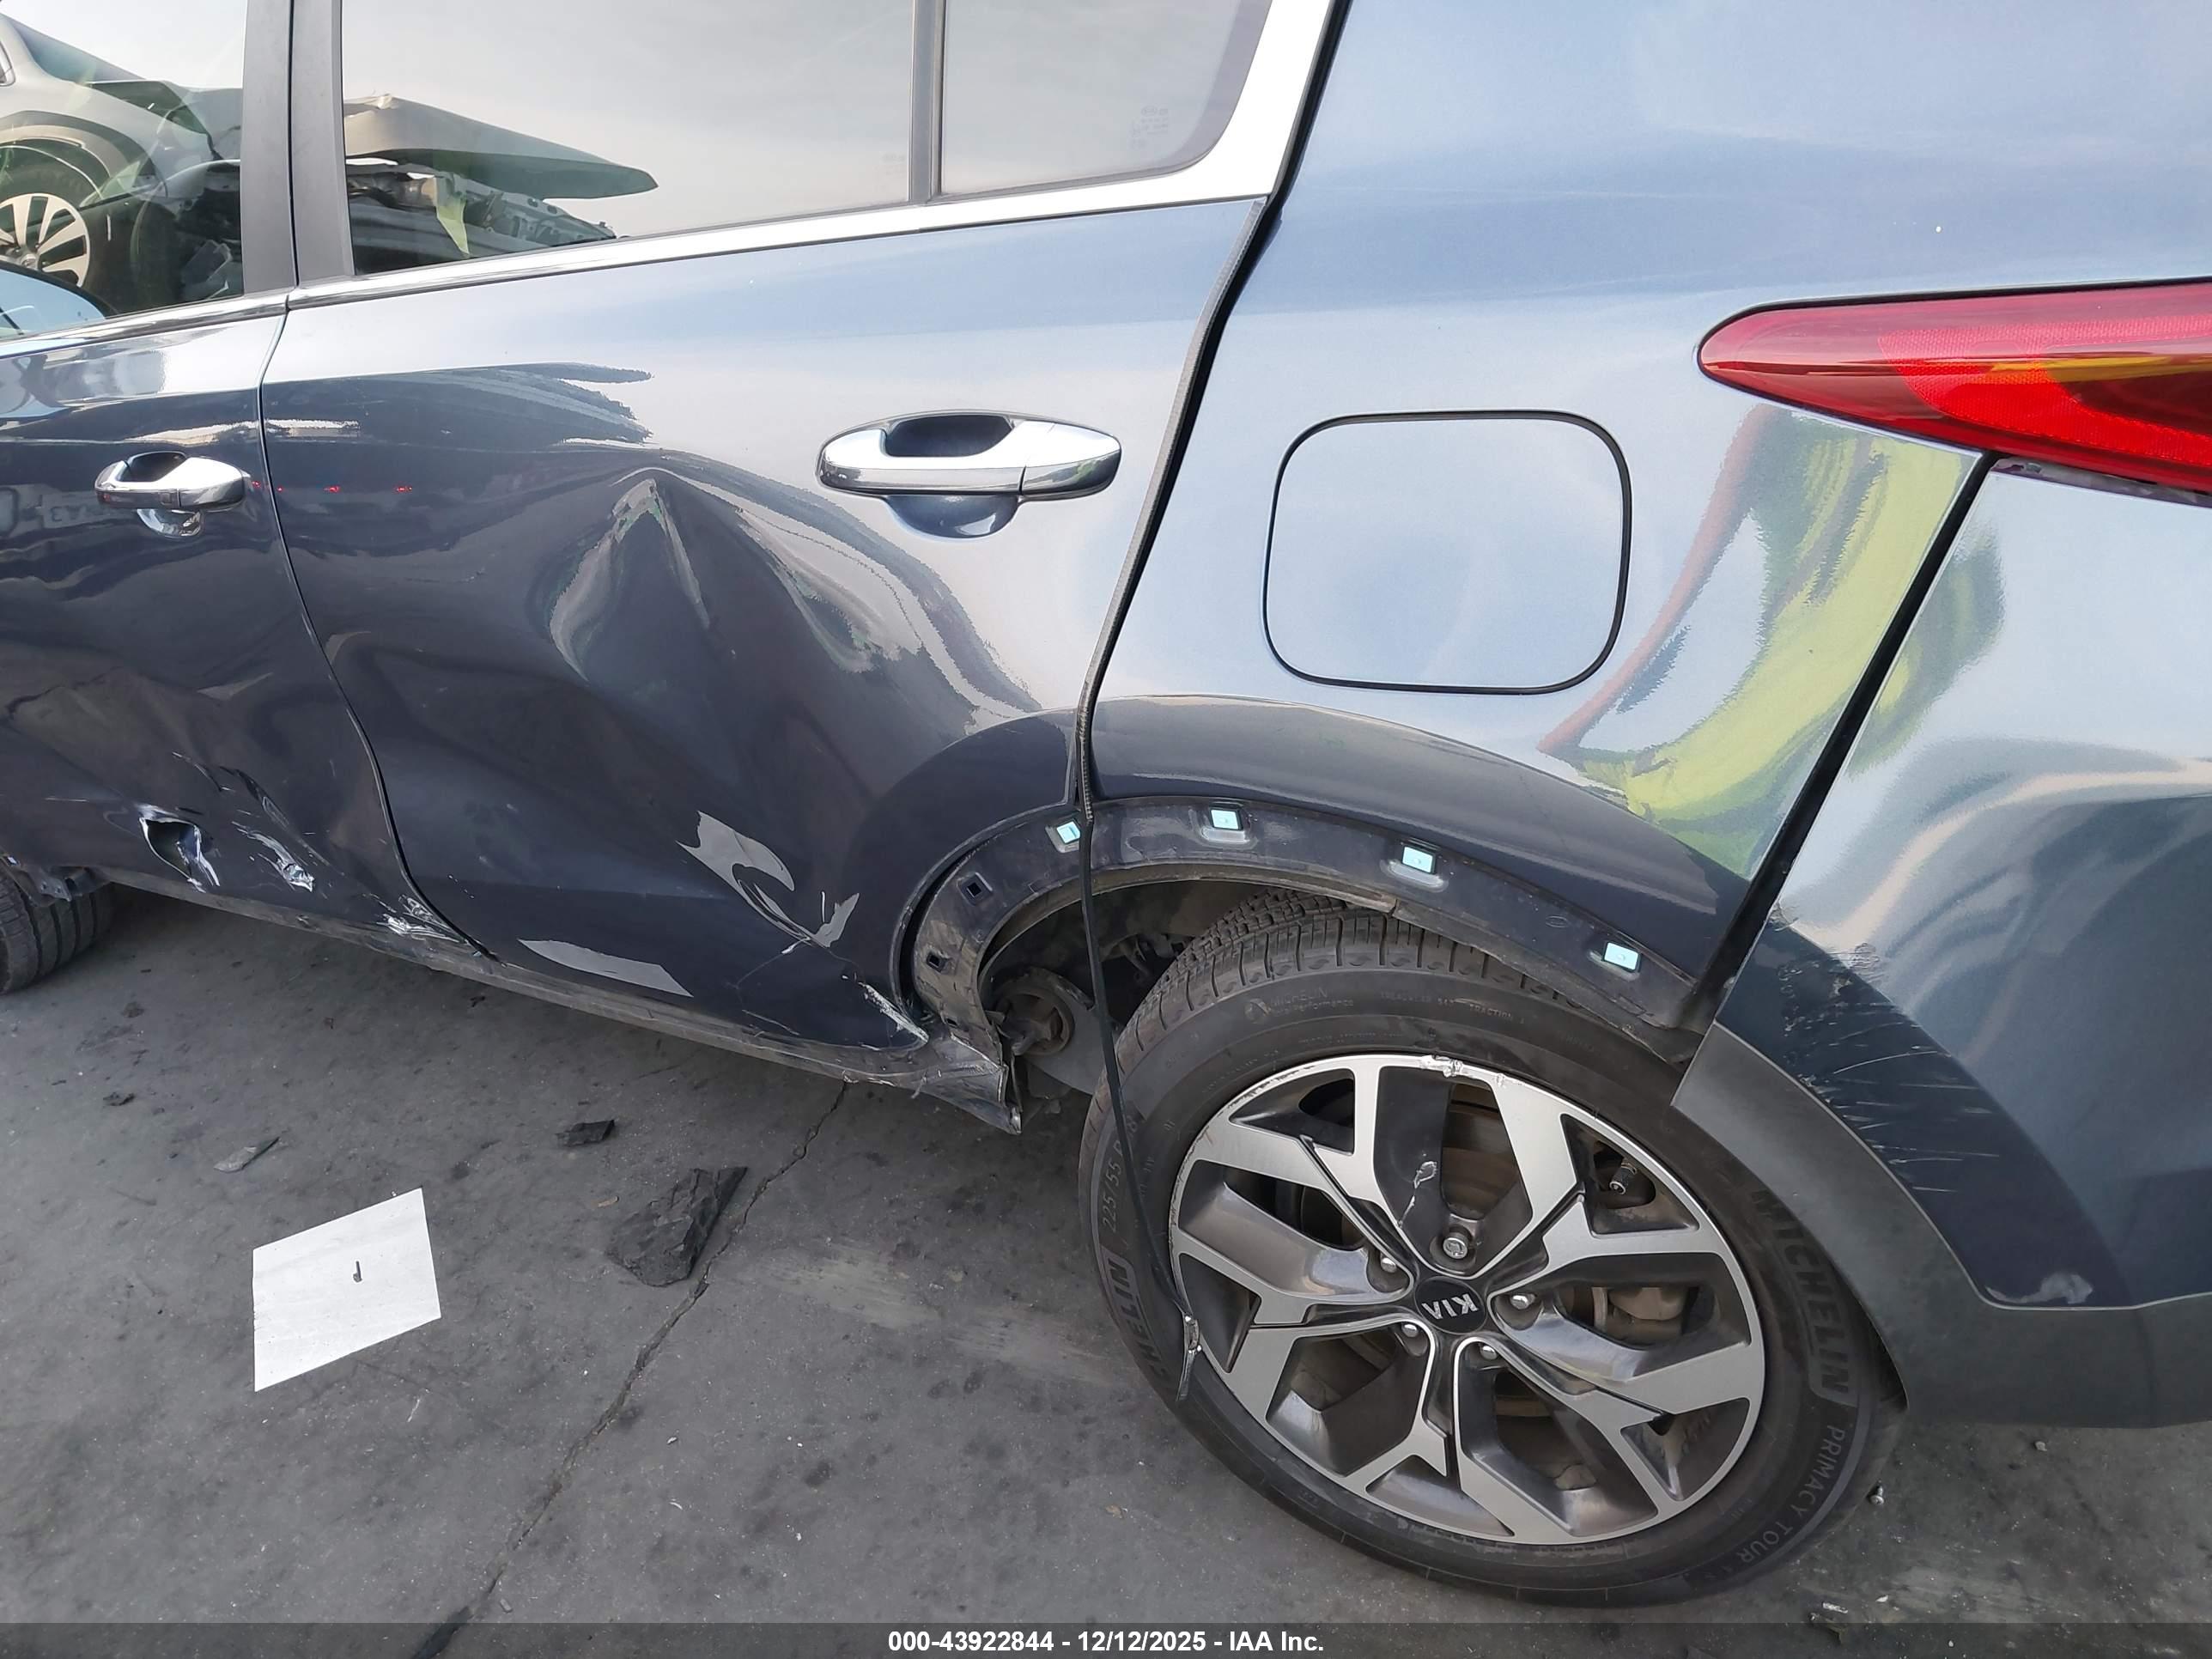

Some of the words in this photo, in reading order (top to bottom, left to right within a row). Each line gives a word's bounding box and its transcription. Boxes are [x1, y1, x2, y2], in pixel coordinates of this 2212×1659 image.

[1102, 1157, 1123, 1233] 225/55
[1421, 1293, 1480, 1320] KIA
[1751, 1189, 1850, 1394] MICHELIN
[1790, 1425, 1845, 1518] PRIMACY
[1736, 1521, 1793, 1563] TOUR
